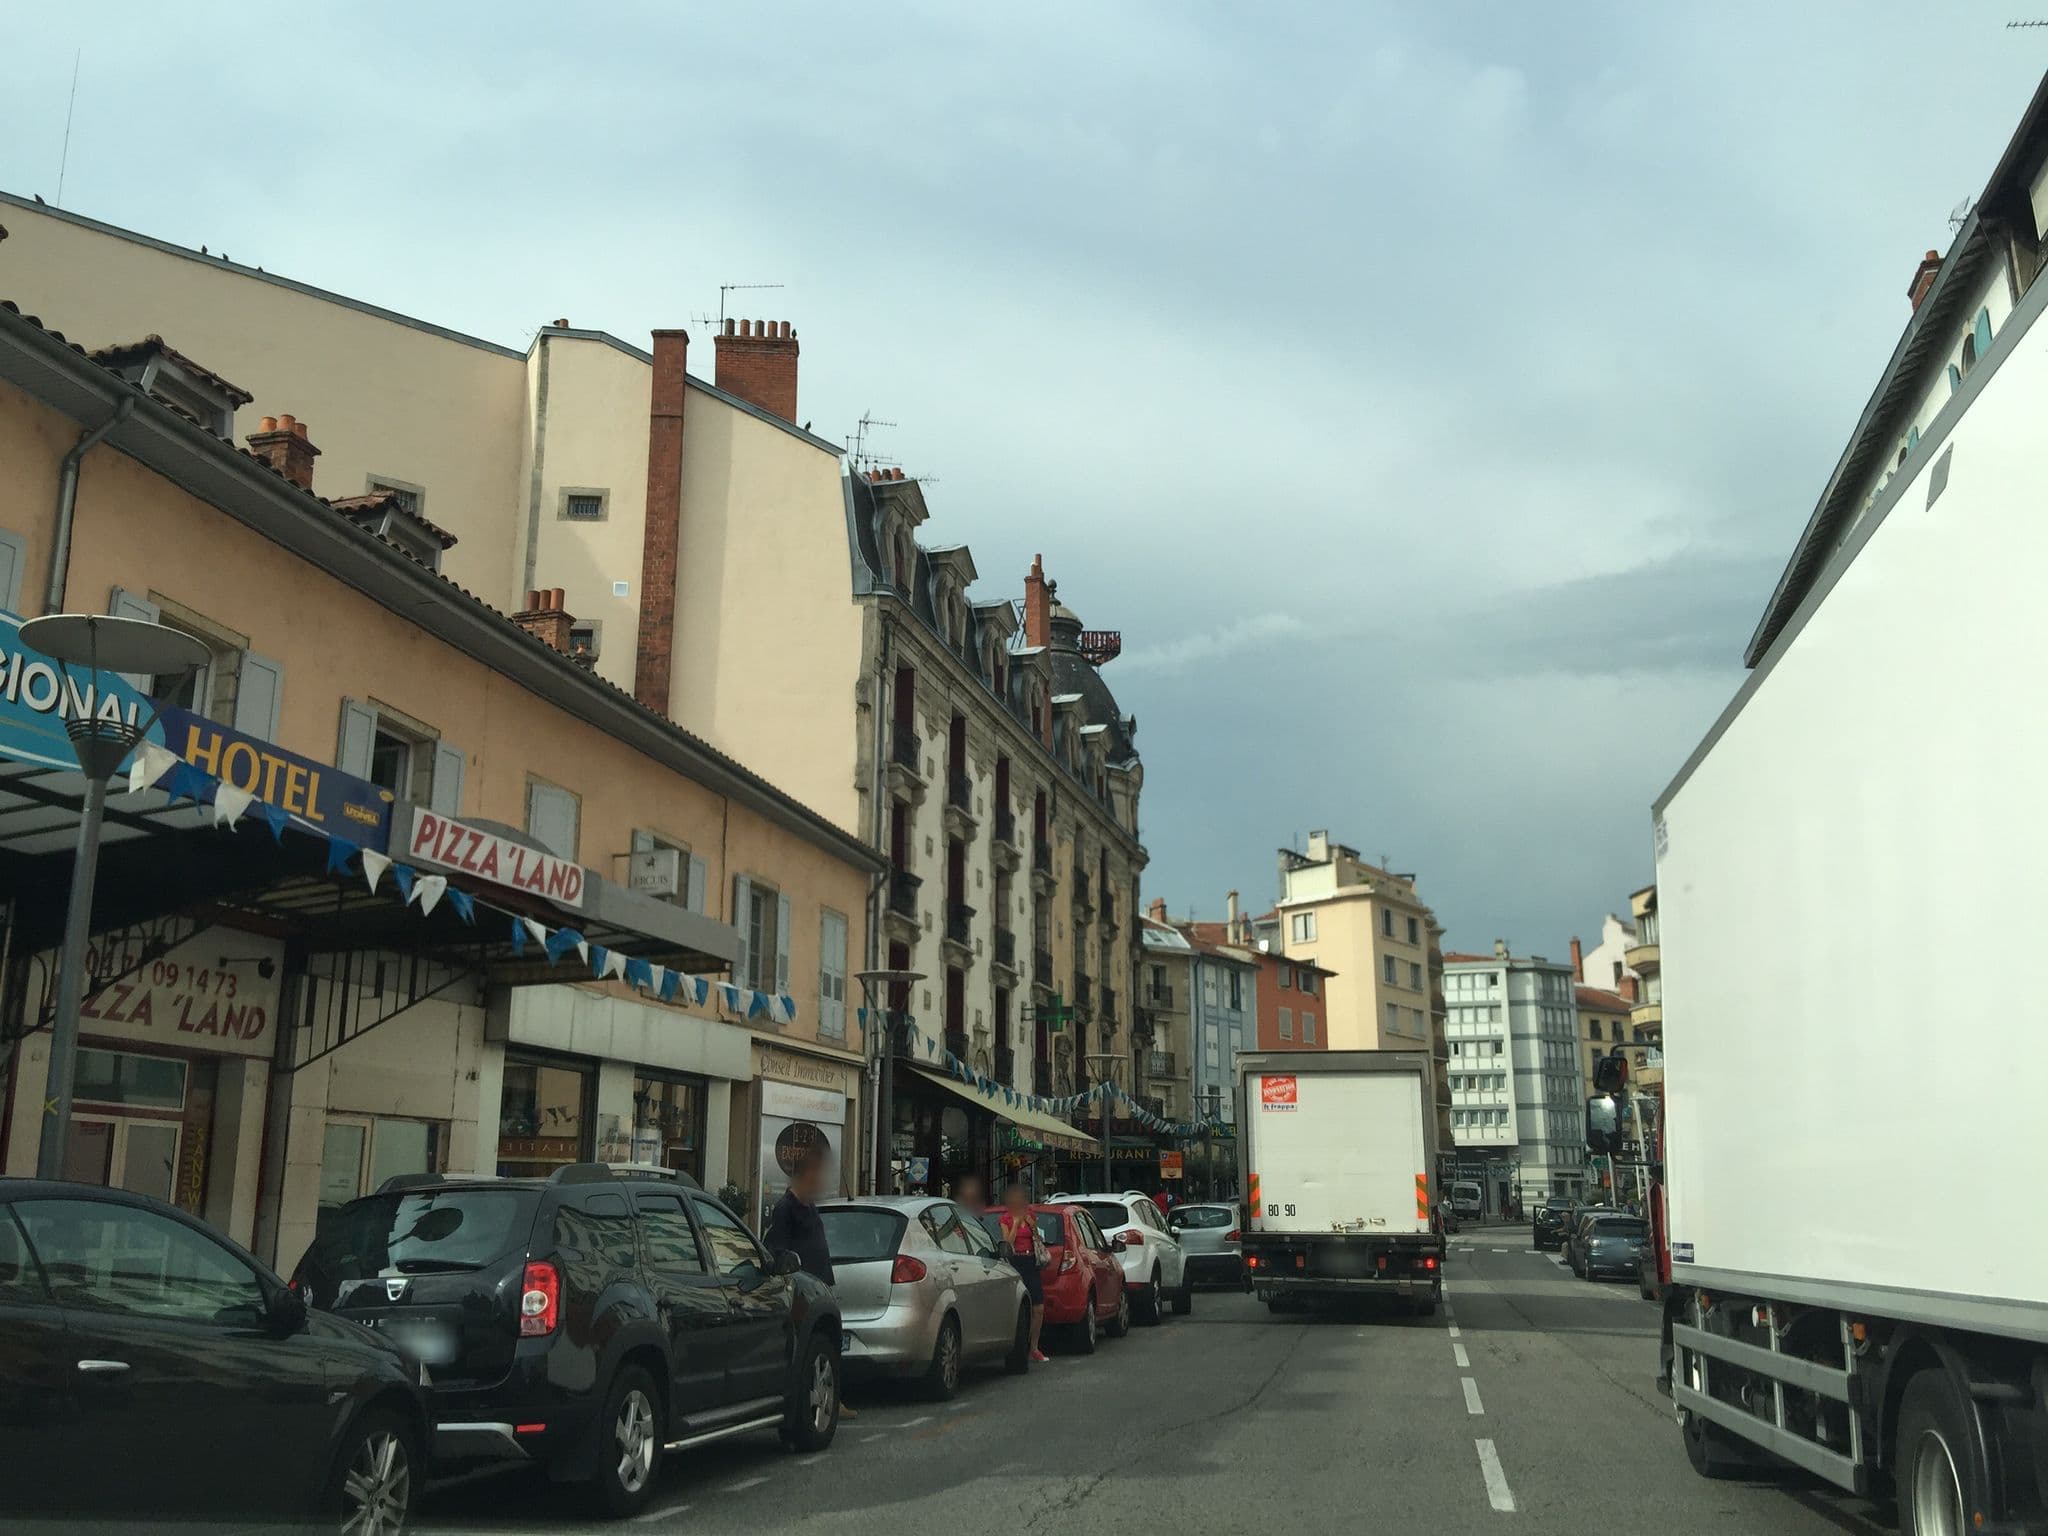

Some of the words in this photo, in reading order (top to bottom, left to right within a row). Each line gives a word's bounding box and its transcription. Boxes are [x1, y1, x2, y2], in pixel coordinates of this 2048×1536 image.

[185, 724, 325, 822] HOTEL
[413, 814, 499, 879] PIZZA
[152, 960, 179, 987] 09
[186, 965, 209, 993] 14
[215, 971, 238, 998] 73
[1268, 1204, 1279, 1217] 80
[1284, 1204, 1296, 1217] 90
